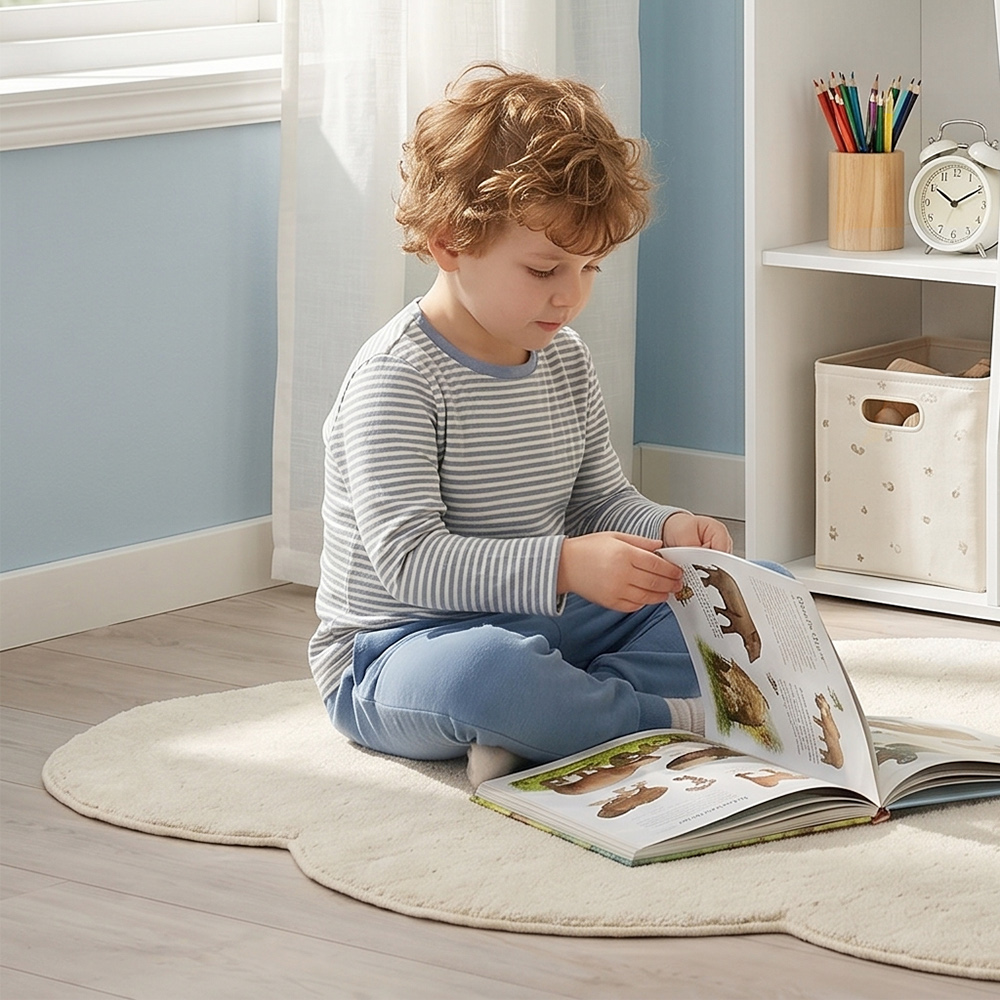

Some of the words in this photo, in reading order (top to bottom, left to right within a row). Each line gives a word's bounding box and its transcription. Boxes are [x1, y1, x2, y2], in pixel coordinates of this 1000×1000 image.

[941, 172, 948, 181] 11
[953, 168, 962, 178] 12
[980, 200, 987, 210] 3
[975, 215, 981, 224] 4
[937, 224, 944, 234] 7
[950, 230, 957, 239] 6
